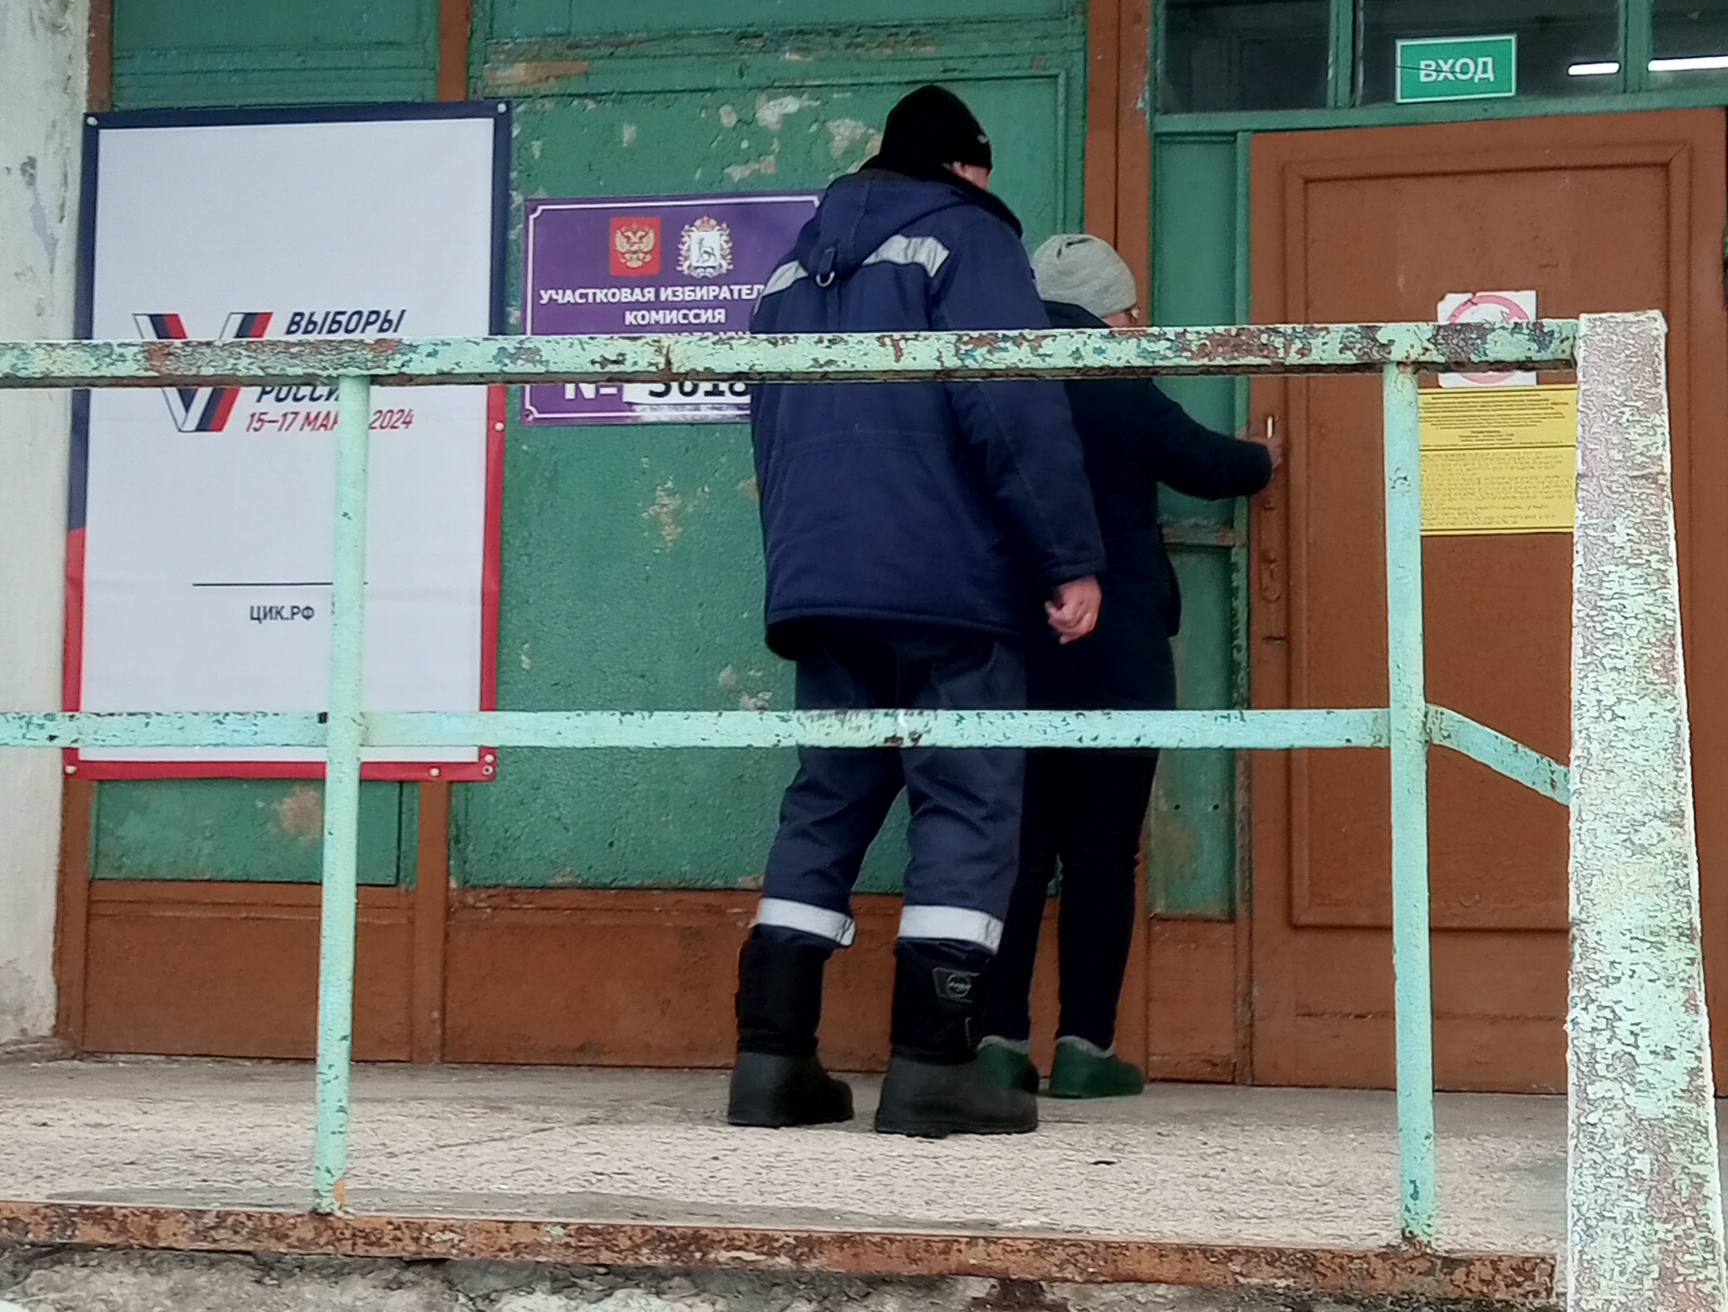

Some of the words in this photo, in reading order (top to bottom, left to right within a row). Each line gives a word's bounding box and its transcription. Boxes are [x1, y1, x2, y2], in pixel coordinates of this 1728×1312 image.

[1419, 57, 1495, 83] ВХОД
[539, 288, 655, 305] УЧАСТКОВАЯ
[659, 284, 765, 302] ИЗБИРАТЕЛ
[285, 309, 407, 336] ВЫБОРЫ
[624, 308, 726, 326] КОМИССИЯ
[255, 385, 339, 403] РОССИ
[368, 408, 415, 430] 2024
[249, 605, 315, 624] ЦИК.РФ
